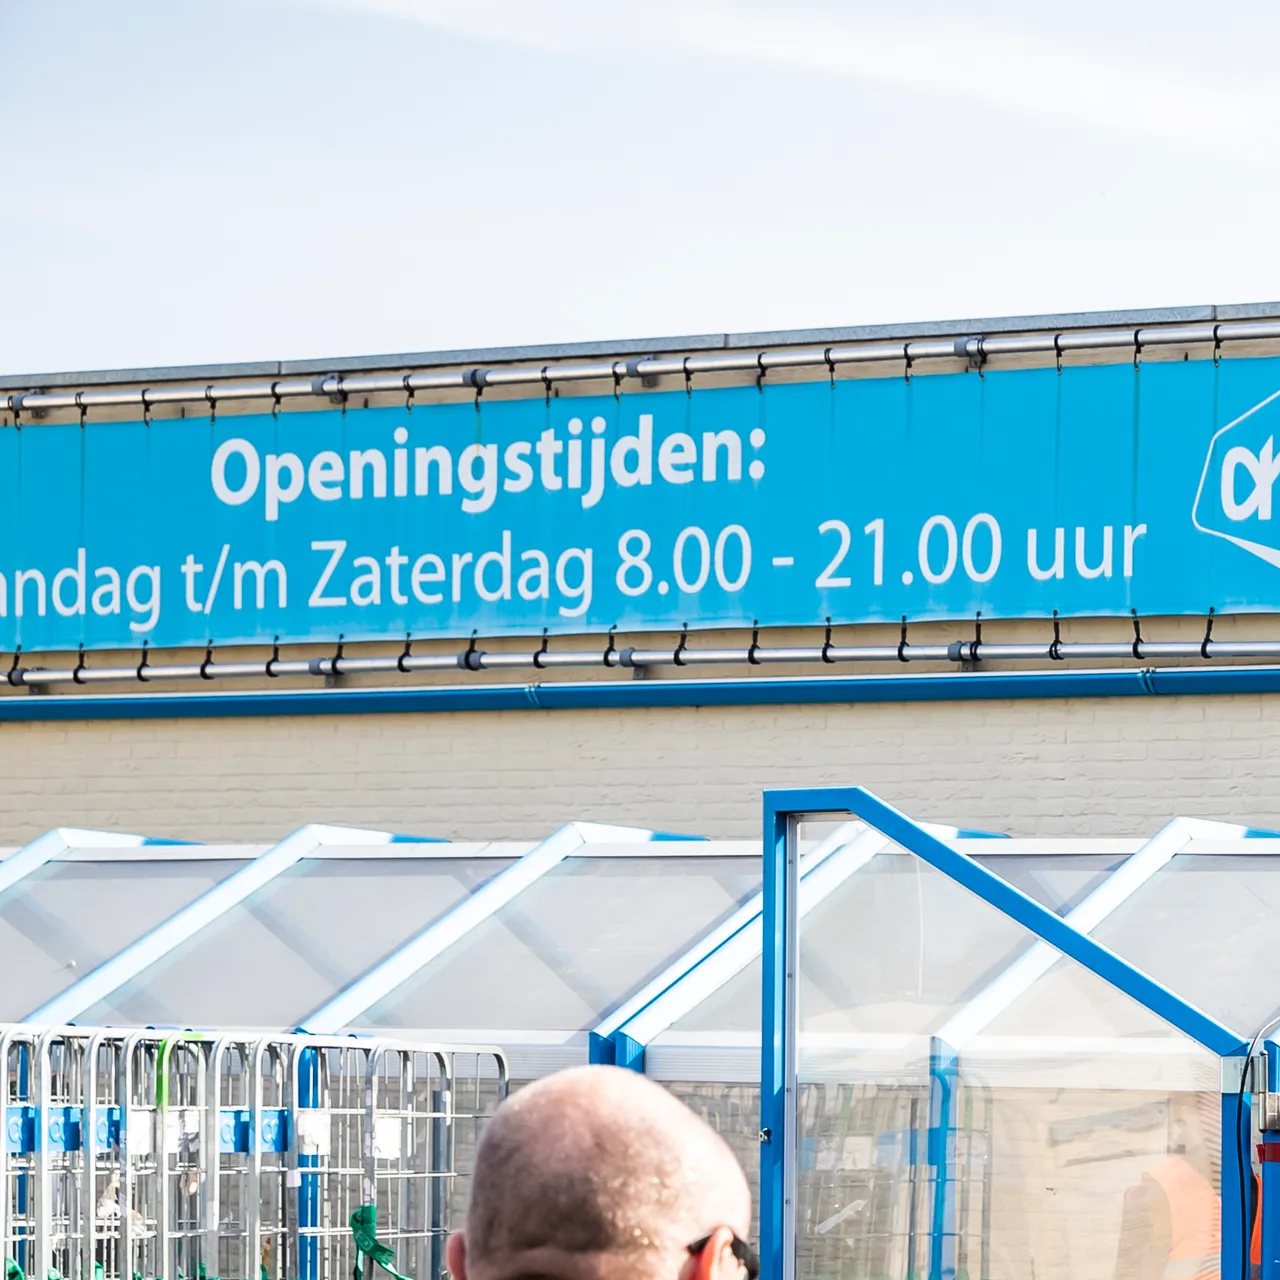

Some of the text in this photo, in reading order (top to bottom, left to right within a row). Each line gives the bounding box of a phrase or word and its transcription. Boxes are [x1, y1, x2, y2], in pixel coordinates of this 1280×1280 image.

[210, 414, 767, 521] Openingstijden:
[0, 512, 1147, 632] ndag t/m Zaterdag 8.00 - 21.00 uur
